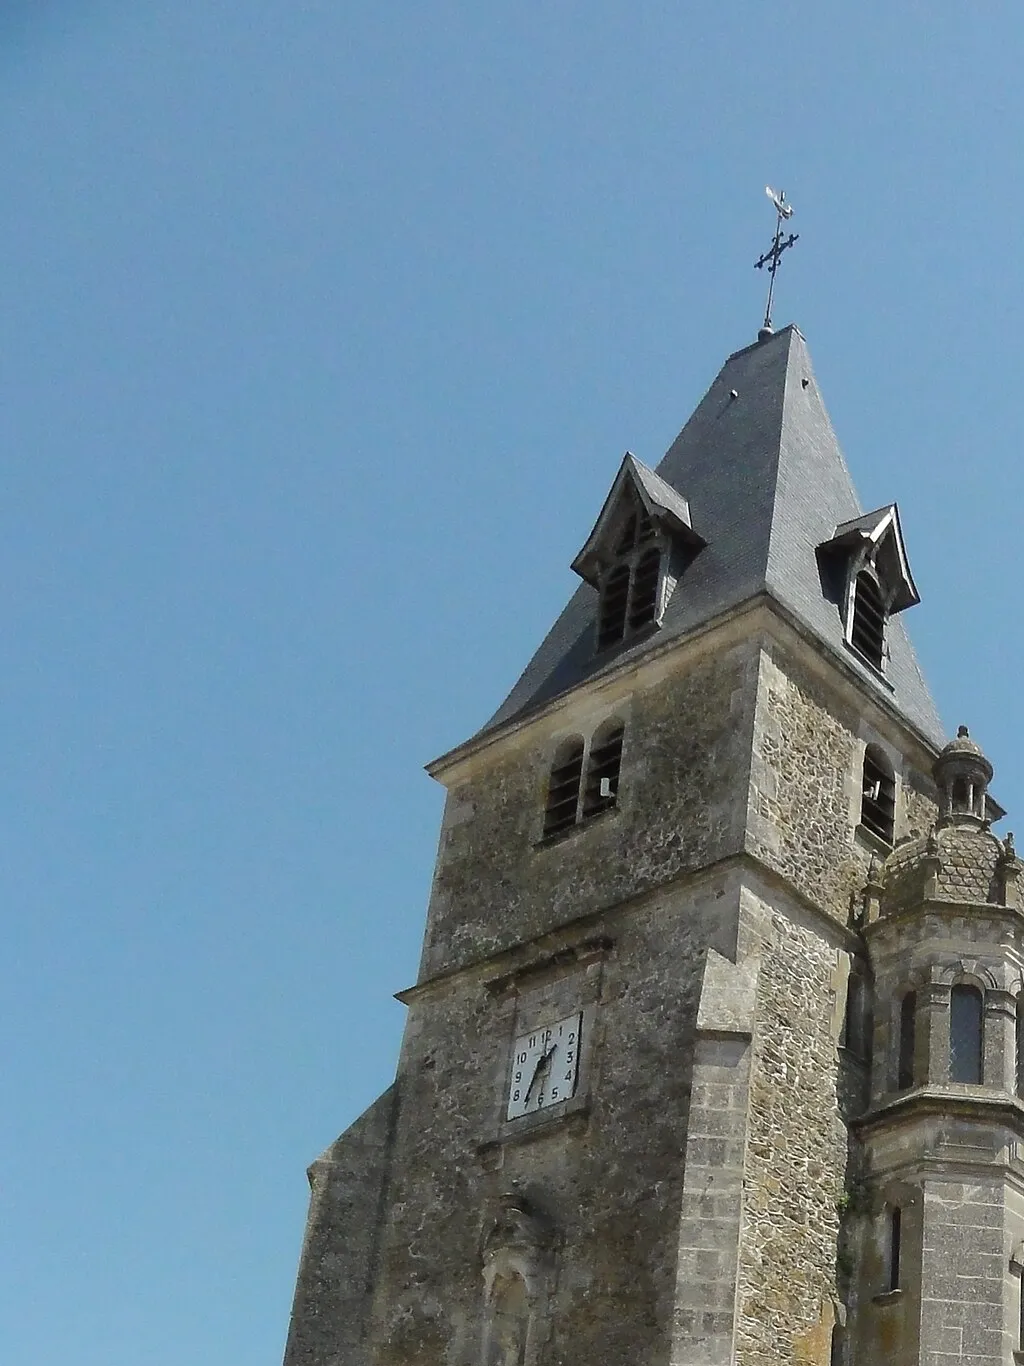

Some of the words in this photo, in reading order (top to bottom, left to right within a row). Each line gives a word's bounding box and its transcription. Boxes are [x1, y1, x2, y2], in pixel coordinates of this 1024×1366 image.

[559, 1026, 562, 1036] 1
[529, 1036, 536, 1048] 11
[568, 1032, 575, 1045] 2
[517, 1052, 527, 1065] 10
[567, 1051, 574, 1063] 3
[515, 1071, 522, 1083] 9
[564, 1070, 572, 1081] 4
[513, 1089, 520, 1101] 8
[537, 1092, 544, 1107] 6
[552, 1087, 559, 1100] 5
